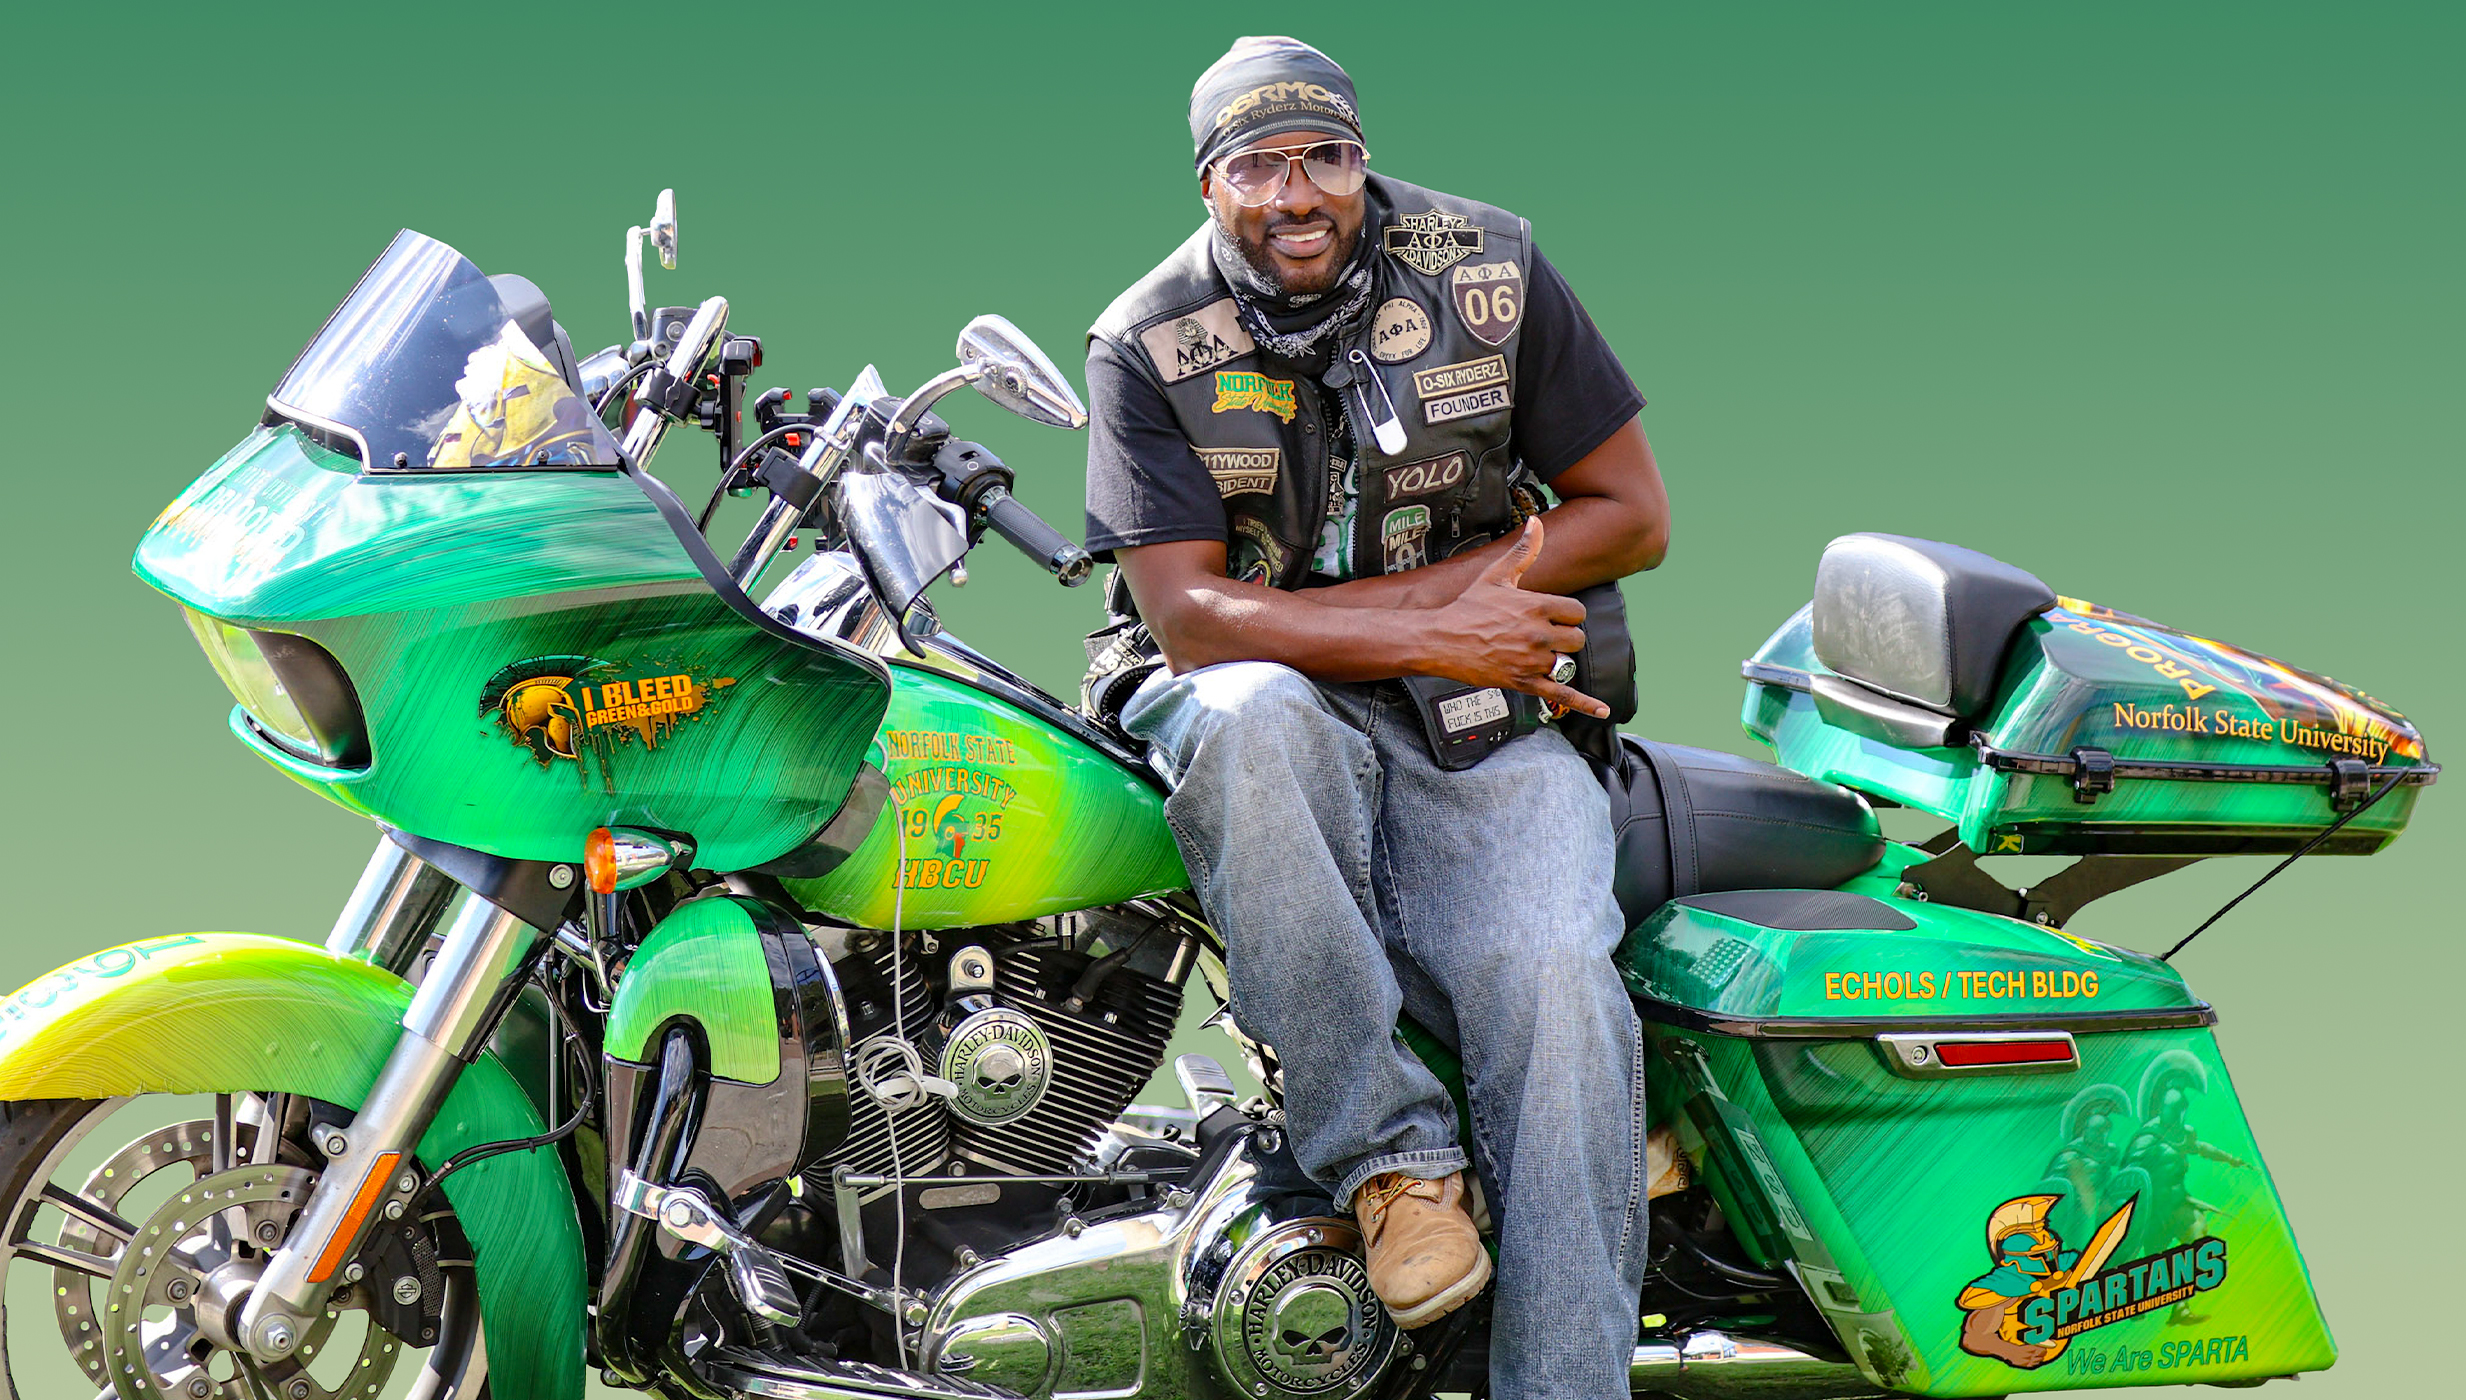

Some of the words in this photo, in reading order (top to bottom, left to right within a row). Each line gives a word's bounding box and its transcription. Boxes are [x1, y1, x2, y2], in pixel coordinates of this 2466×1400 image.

[1251, 102, 1297, 120] Ryderz
[1411, 216, 1455, 231] HARLEY
[1409, 249, 1457, 271] DAVIDSON
[1465, 285, 1517, 325] 06
[1423, 373, 1456, 391] O-SIX
[1456, 361, 1501, 386] RYDERZ
[1431, 389, 1504, 418] FOUNDER
[1388, 456, 1464, 500] YOLO
[1389, 511, 1425, 534] MILE
[1389, 529, 1422, 551] MILE
[581, 686, 594, 712] I
[601, 673, 694, 709] BLEED
[1443, 700, 1463, 715] WHO
[1466, 695, 1482, 708] THE
[585, 696, 693, 728] GREEN&GOLD
[1447, 713, 1472, 729] FUCK
[1474, 710, 1483, 722] IS
[1484, 704, 1501, 719] THIS
[886, 731, 961, 762] NORFOLK
[964, 734, 1018, 766] STATE
[2113, 702, 2209, 733] Norfolk
[2215, 709, 2273, 741] State
[2280, 717, 2389, 766] University
[890, 767, 1017, 810] UNIVERSITY
[892, 858, 990, 889] HBCU
[1825, 971, 1936, 1000] ECHOLS
[1957, 970, 2026, 999] TECH
[2032, 970, 2100, 999] BLDG
[954, 1024, 1042, 1080] HARLEY-DAVIDSON
[960, 1083, 1037, 1115] MOTORCYCLES
[1248, 1252, 1379, 1337] HARLEY-DAVIDSON
[2023, 1238, 2227, 1346] SPARTANS
[2057, 1316, 2102, 1339] NORFOLK
[2104, 1304, 2136, 1324] STATE
[2137, 1284, 2195, 1313] UNIVERSITY
[1253, 1343, 1368, 1388] MOTORCYCLES
[2067, 1347, 2107, 1375] We
[2109, 1344, 2153, 1374] Are
[2158, 1335, 2249, 1369] SPARTA
